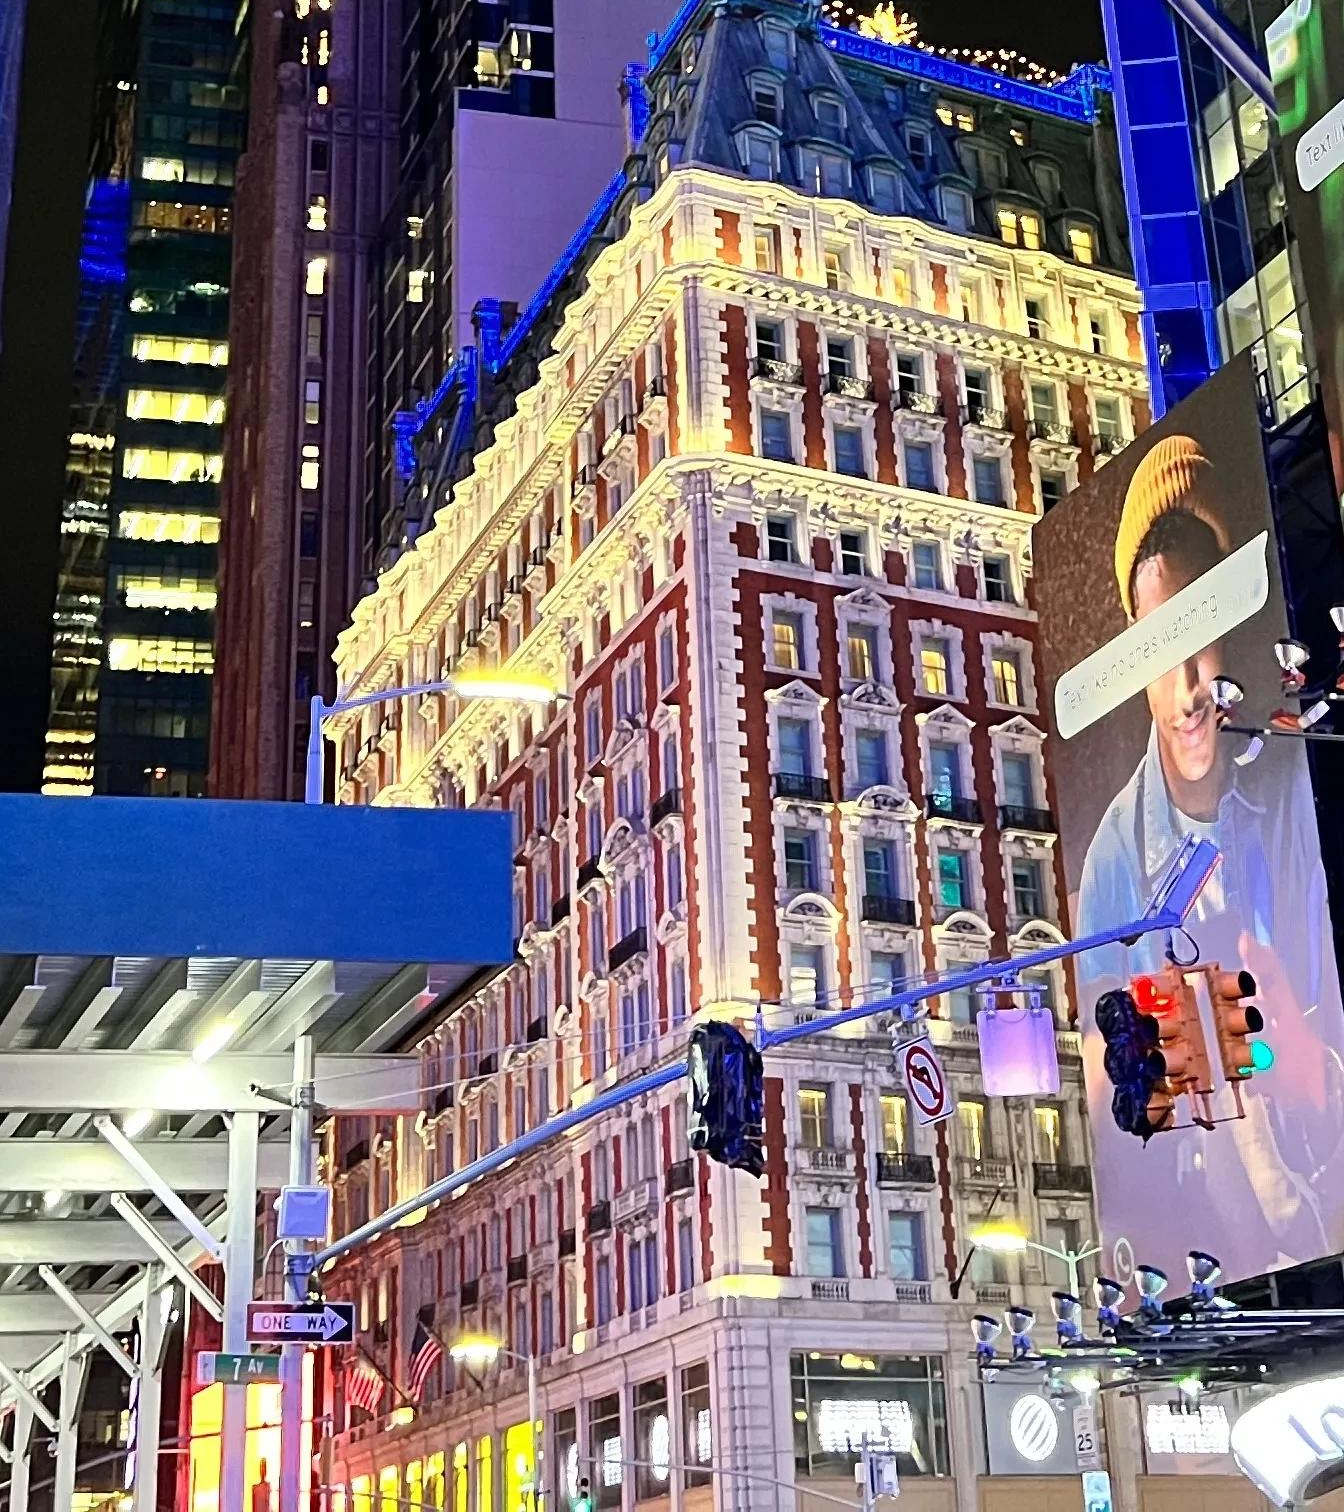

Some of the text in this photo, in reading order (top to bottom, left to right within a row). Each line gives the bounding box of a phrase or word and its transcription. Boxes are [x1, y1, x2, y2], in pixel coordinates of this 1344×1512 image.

[1305, 131, 1334, 167] Text
[261, 1315, 338, 1330] ONE WAY
[232, 1357, 242, 1382] 7
[1077, 1433, 1093, 1452] 25
